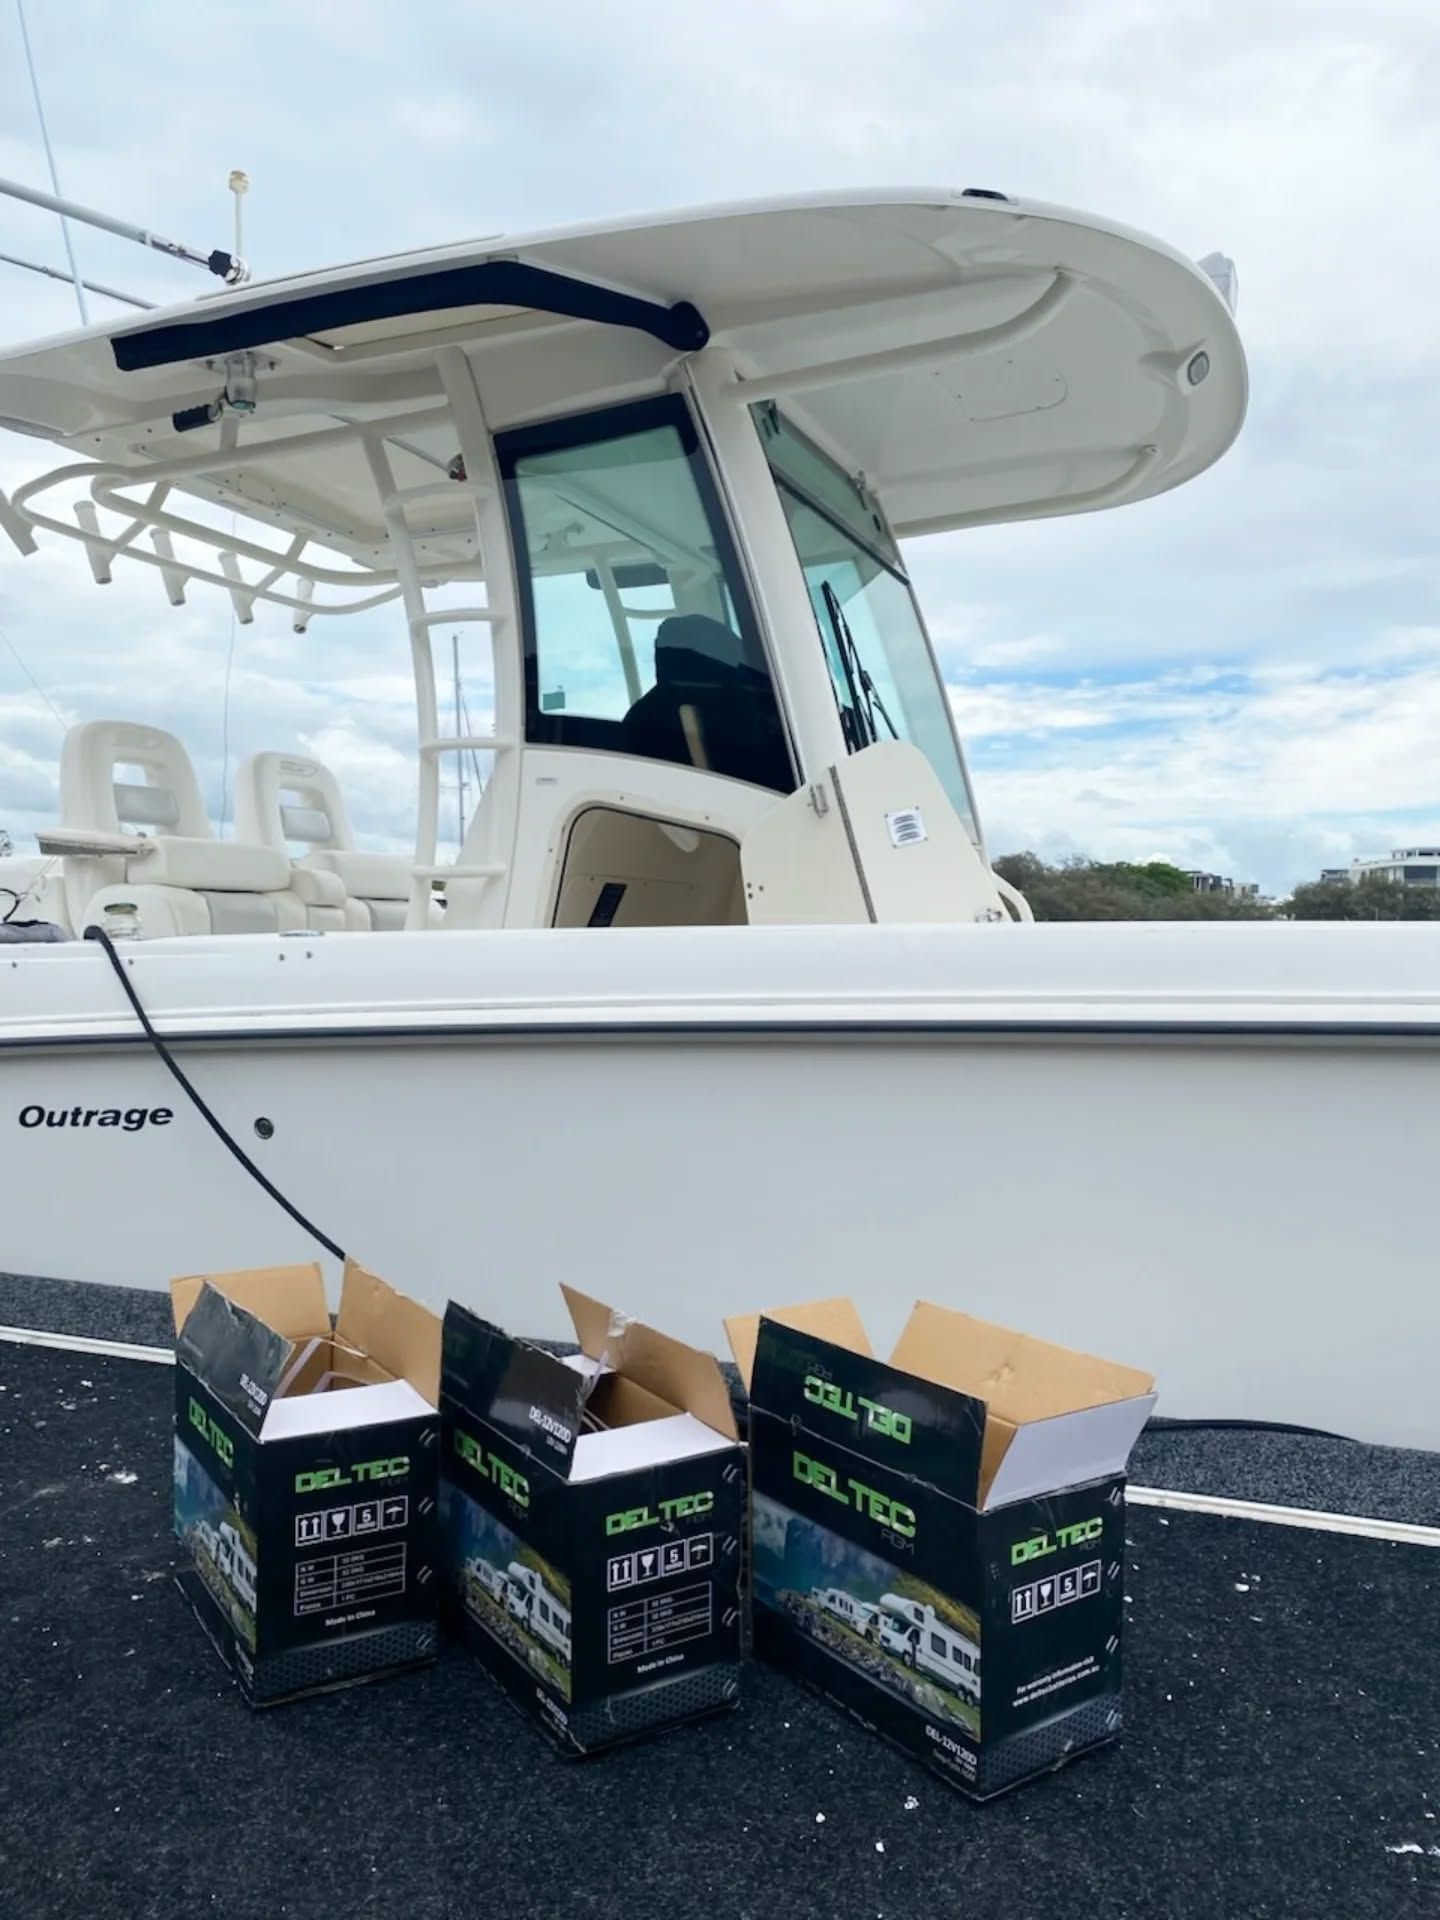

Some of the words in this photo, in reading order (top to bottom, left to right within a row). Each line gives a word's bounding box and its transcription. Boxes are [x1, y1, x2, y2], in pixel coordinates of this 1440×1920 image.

[18, 1104, 175, 1132] Outrage
[188, 1395, 234, 1470] DELTEC
[804, 1374, 912, 1445] DELTEC
[295, 1455, 410, 1494] DELTEC
[452, 1426, 530, 1509] DELTEC
[606, 1490, 714, 1537] DELTEC
[793, 1449, 916, 1539] DELTEC
[1011, 1516, 1104, 1566] DELTEC
[1064, 1576, 1074, 1592] 5
[925, 1724, 977, 1765] DEL-12V120D
